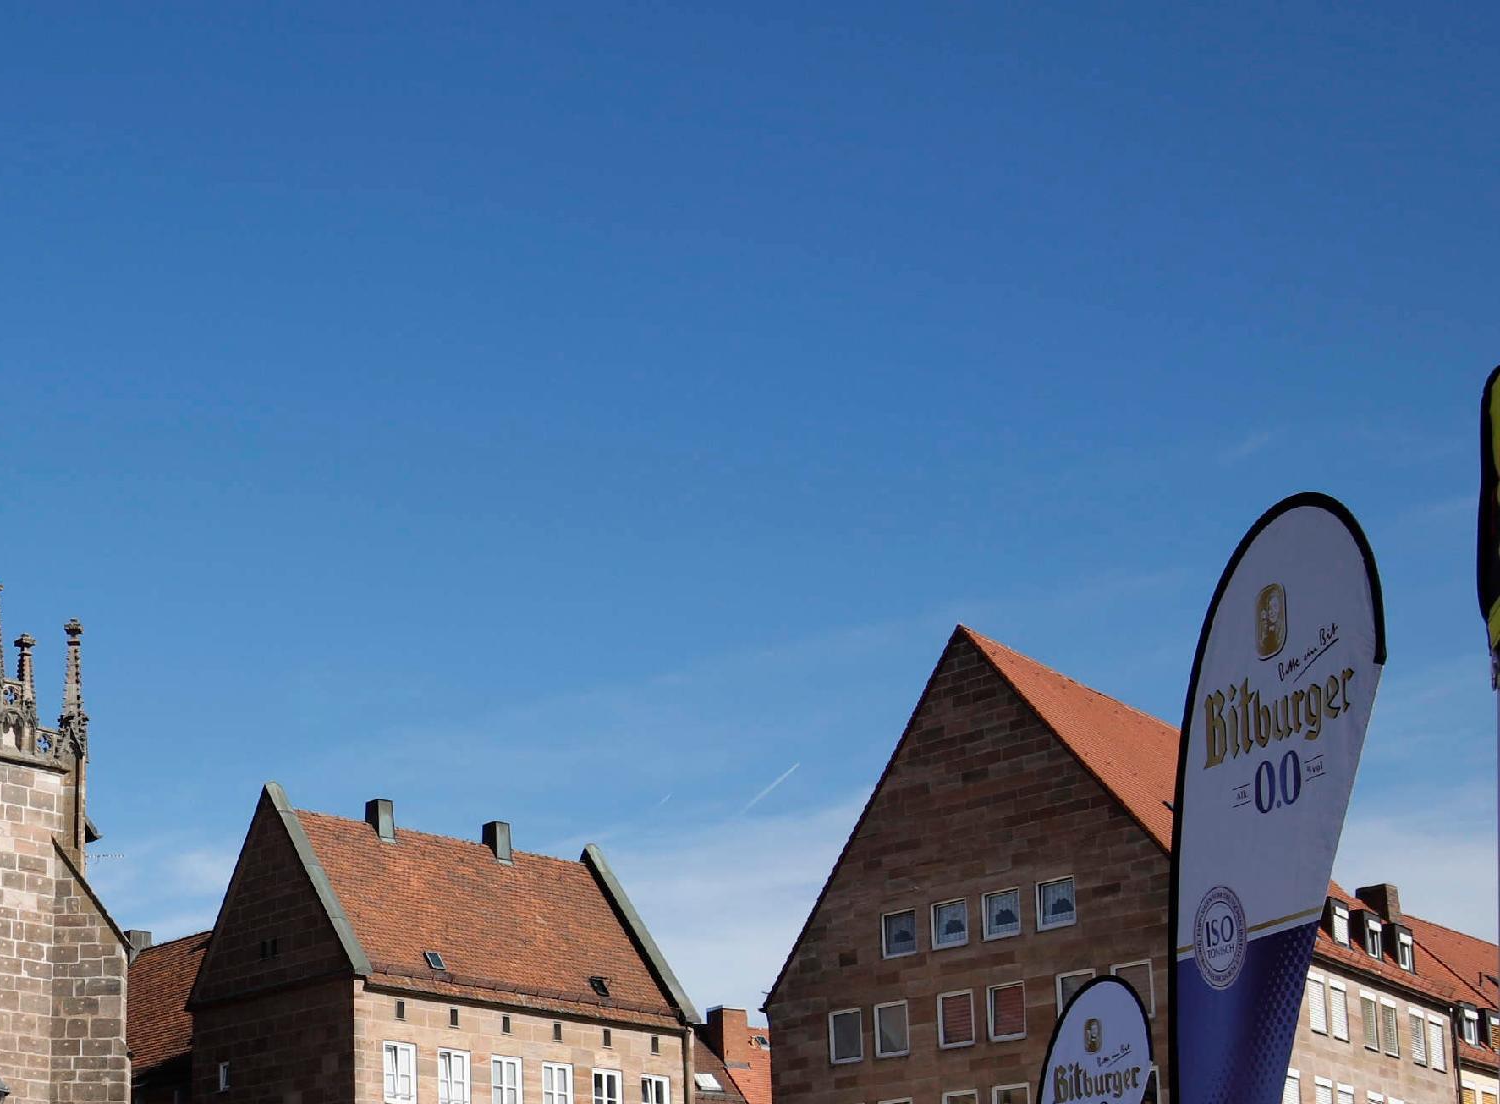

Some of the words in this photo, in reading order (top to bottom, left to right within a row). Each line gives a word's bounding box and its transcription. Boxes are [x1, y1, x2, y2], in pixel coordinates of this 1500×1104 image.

[1204, 667, 1355, 770] Bitburger
[1255, 750, 1300, 813] 0.0
[1206, 915, 1234, 948] ISO
[1052, 1061, 1141, 1104] Bitburger
